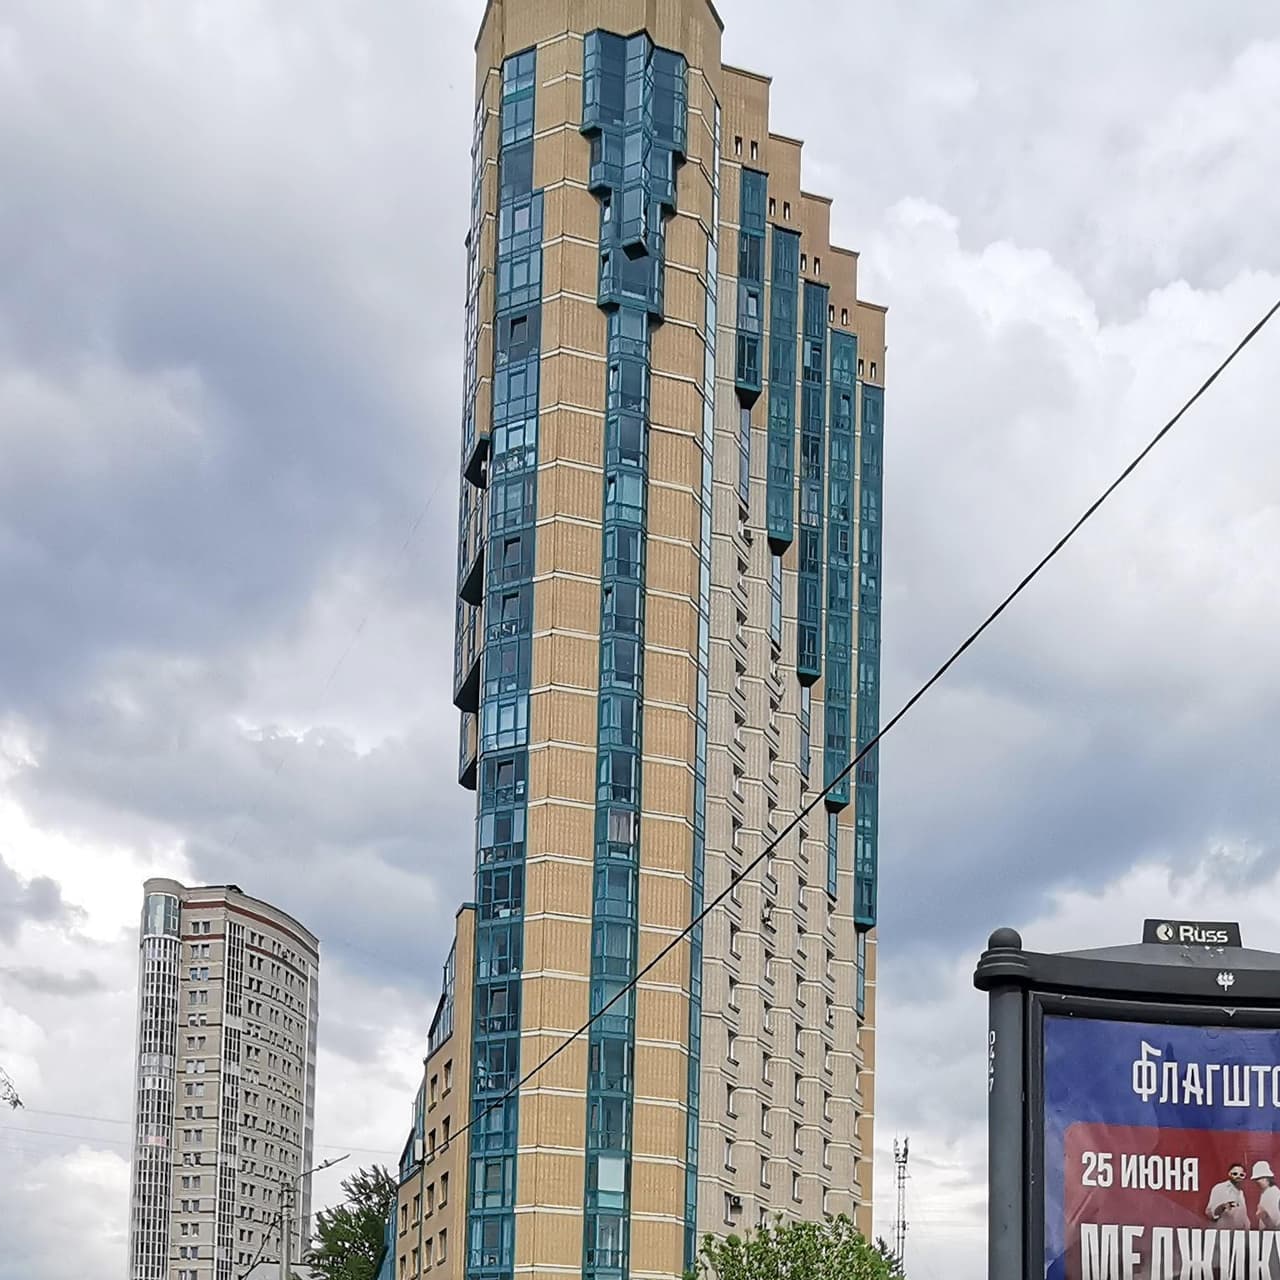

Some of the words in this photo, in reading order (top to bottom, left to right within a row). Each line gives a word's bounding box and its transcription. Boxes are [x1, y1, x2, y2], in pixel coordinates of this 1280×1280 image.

[1179, 925, 1228, 943] Russ
[1081, 1151, 1113, 1188] 25
[1121, 1153, 1199, 1192] ИЮНЯ
